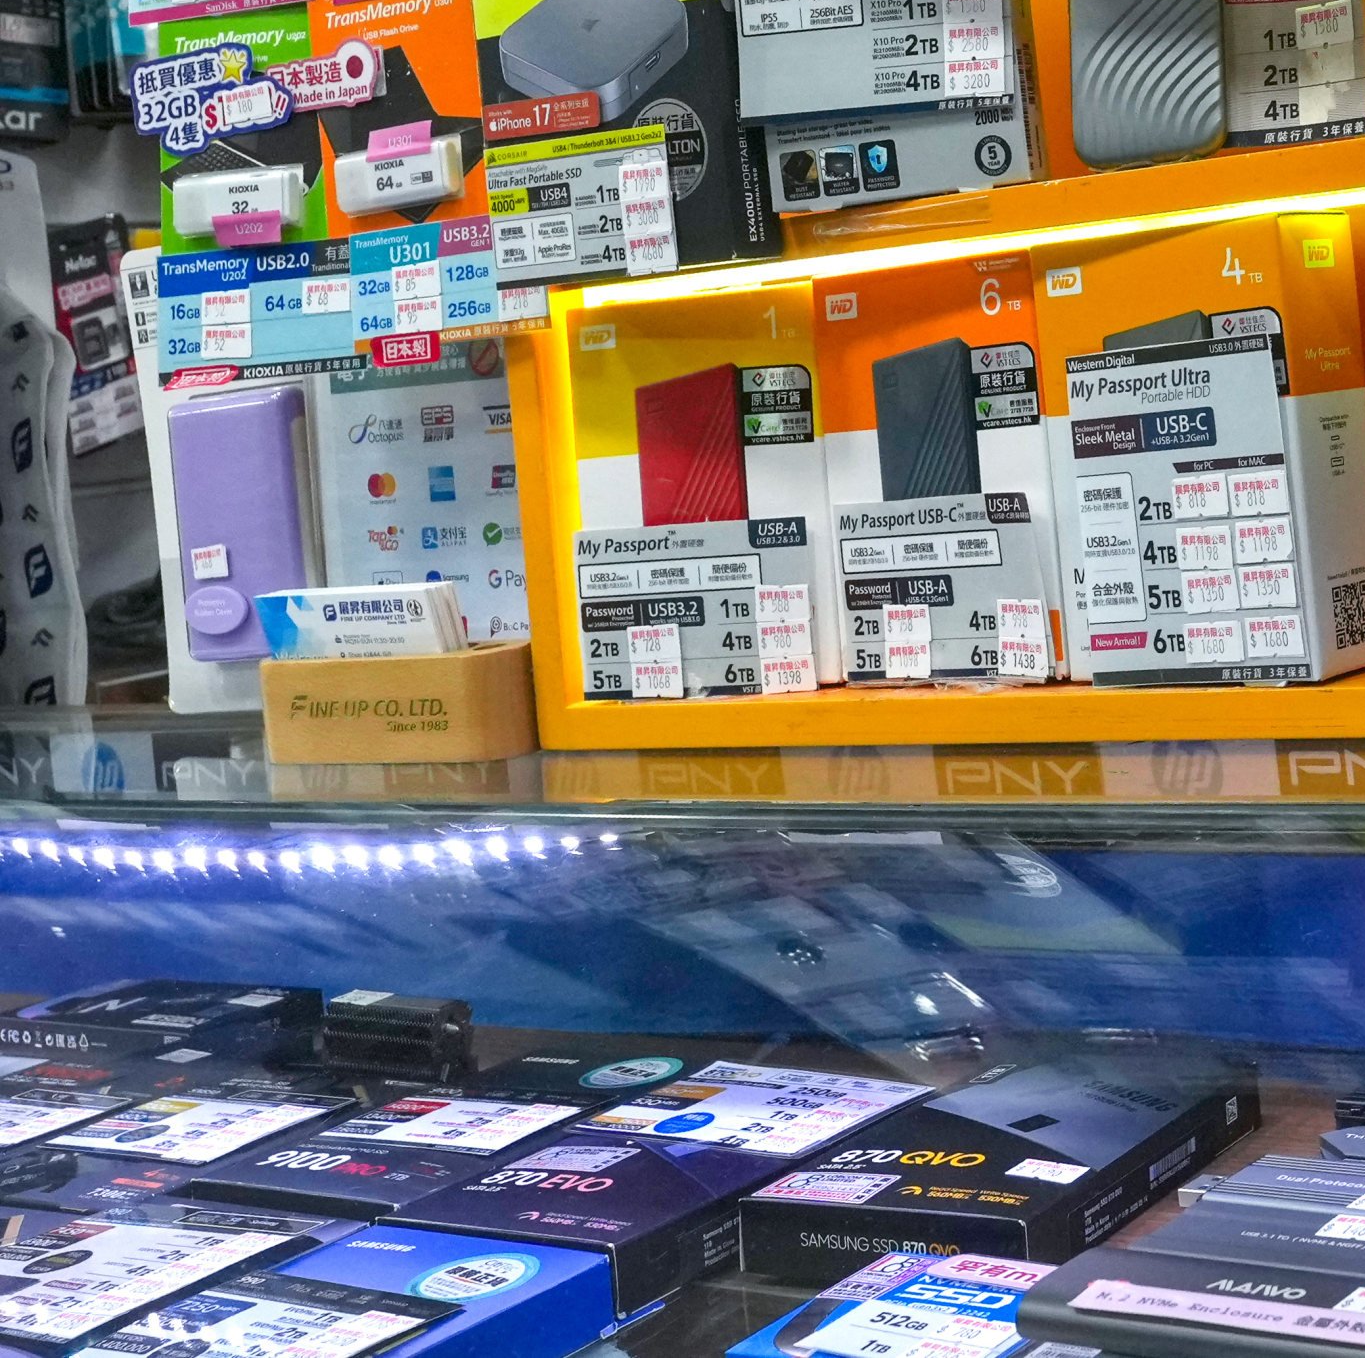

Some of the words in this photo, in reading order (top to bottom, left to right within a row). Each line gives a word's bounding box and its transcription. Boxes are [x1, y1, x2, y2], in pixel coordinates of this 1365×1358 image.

[137, 58, 217, 92] 抵買優惠
[142, 95, 196, 124] 32GB
[169, 125, 200, 147] 4隻
[227, 184, 260, 194] KIOXIA
[443, 224, 490, 243] USB3.2
[1067, 358, 1104, 373] Western
[1106, 353, 1135, 369] Digital
[1070, 378, 1094, 402] My
[1098, 370, 1167, 397] Passport
[1171, 365, 1211, 386] Ultra
[1156, 412, 1208, 434] USB-C
[338, 598, 404, 615] 展昇有限公司
[344, 700, 369, 718] UP
[374, 699, 404, 718] CO.
[409, 698, 449, 717] LTD.
[256, 1149, 346, 1173] 9100
[330, 1160, 388, 1178] PRO
[831, 1148, 903, 1164] 870
[899, 1151, 987, 1169] QVO
[480, 1171, 548, 1187] 870
[544, 1172, 615, 1195] EVO
[346, 1239, 416, 1253] SAMSUNG
